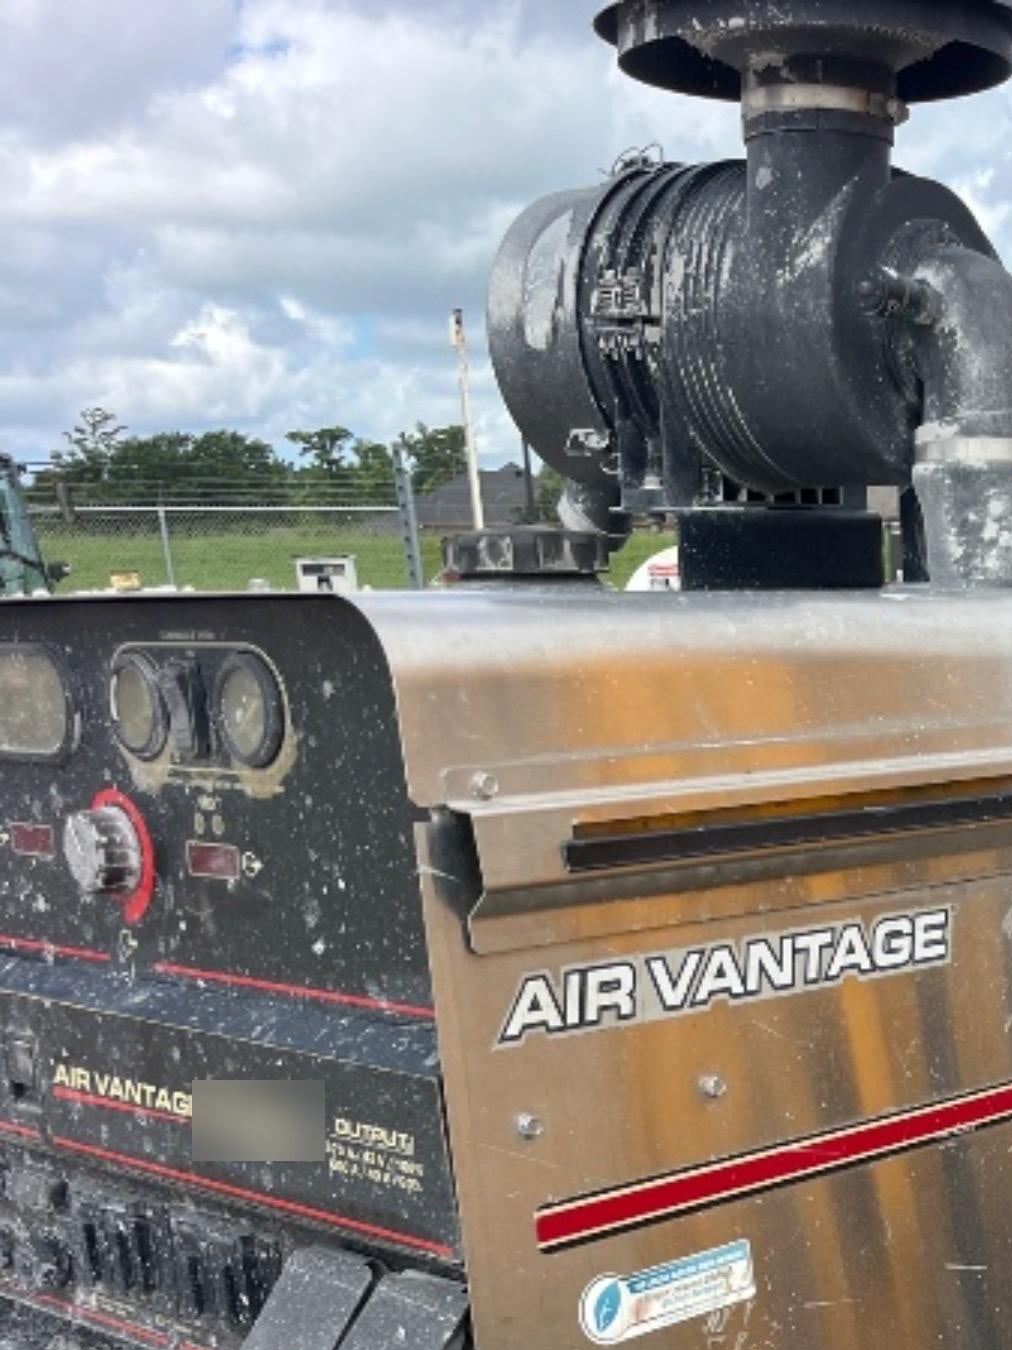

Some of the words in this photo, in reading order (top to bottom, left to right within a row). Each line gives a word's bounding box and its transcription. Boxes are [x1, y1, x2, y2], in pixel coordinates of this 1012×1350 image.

[499, 962, 637, 1044] AIR
[645, 909, 950, 1013] VANTAGE
[53, 1063, 91, 1092] AIR
[335, 1118, 412, 1153] OUTPUT
